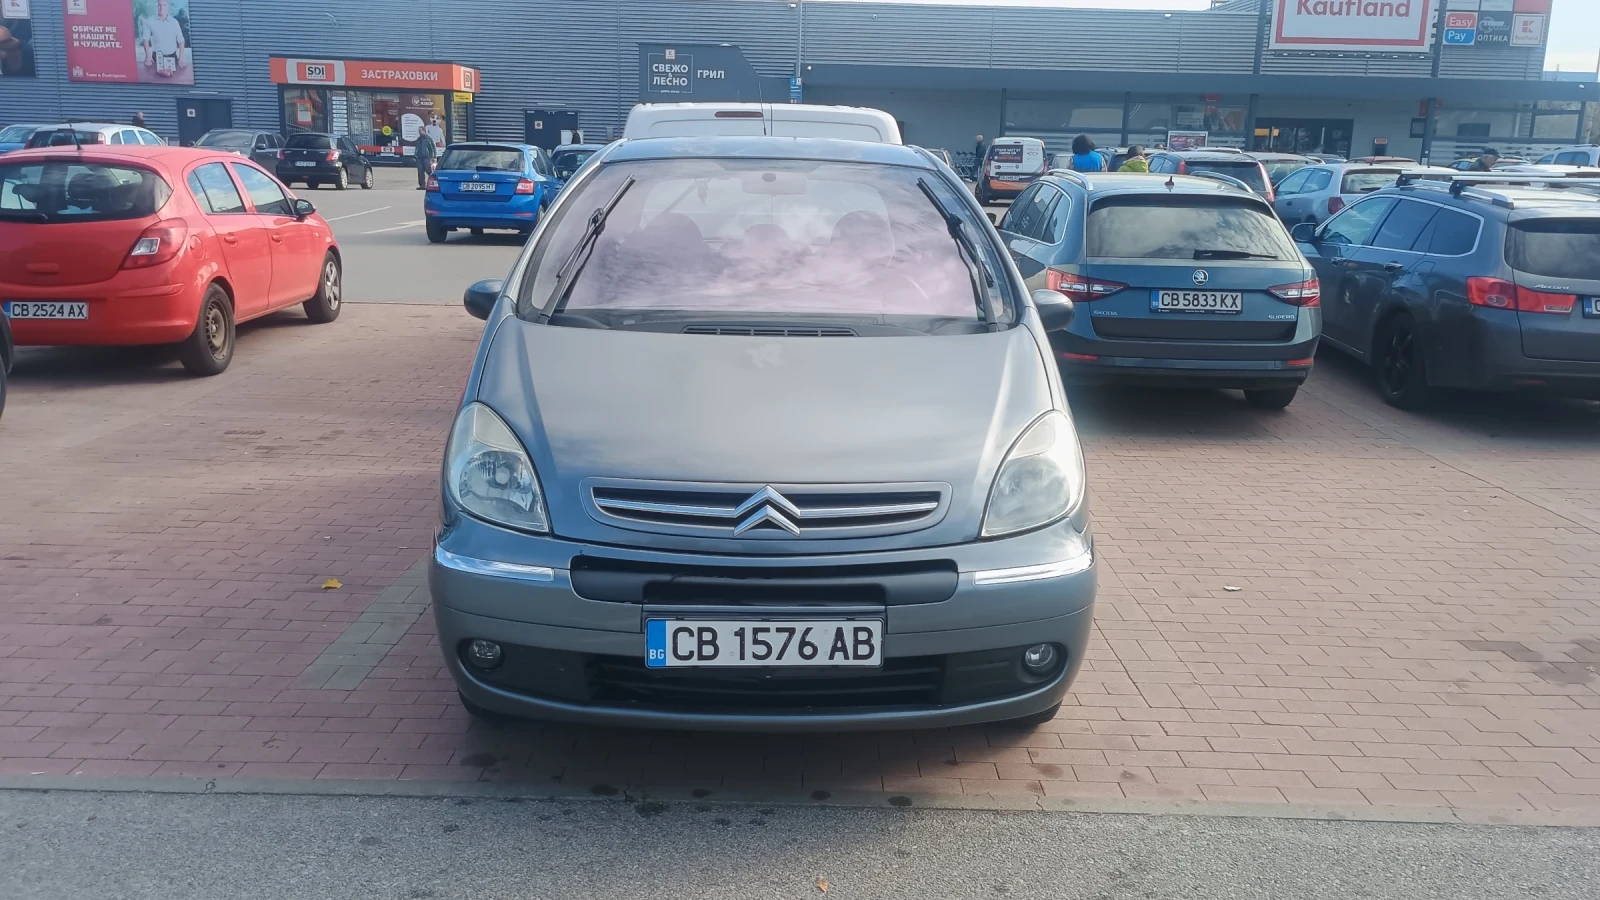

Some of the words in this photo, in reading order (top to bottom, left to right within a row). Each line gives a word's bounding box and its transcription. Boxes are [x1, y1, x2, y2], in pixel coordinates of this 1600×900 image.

[1296, 0, 1411, 17] Kaufland
[1449, 17, 1473, 27] Easy
[72, 25, 104, 33] ОБИЧАТ
[80, 33, 117, 41] НАШИТЕ,
[1448, 31, 1467, 41] Pay
[1477, 34, 1508, 42] ОПТИКА
[80, 41, 123, 49] ЧУЖДИТЕ.
[307, 66, 325, 76] SDI
[652, 63, 689, 73] СВЕЖО
[361, 69, 438, 81] ЗАСТРАХОВКИ
[697, 69, 725, 79] ГРИЛ
[652, 76, 688, 86] ЛЕСНО
[1161, 293, 1180, 307] CB
[1182, 293, 1217, 308] 5833
[1220, 294, 1239, 309] KX
[12, 303, 30, 317] CB
[32, 304, 64, 317] 2524
[68, 304, 85, 317] AX
[649, 649, 664, 660] BG
[672, 626, 720, 661] CB
[733, 626, 819, 661] 1576
[828, 626, 875, 661] AB
